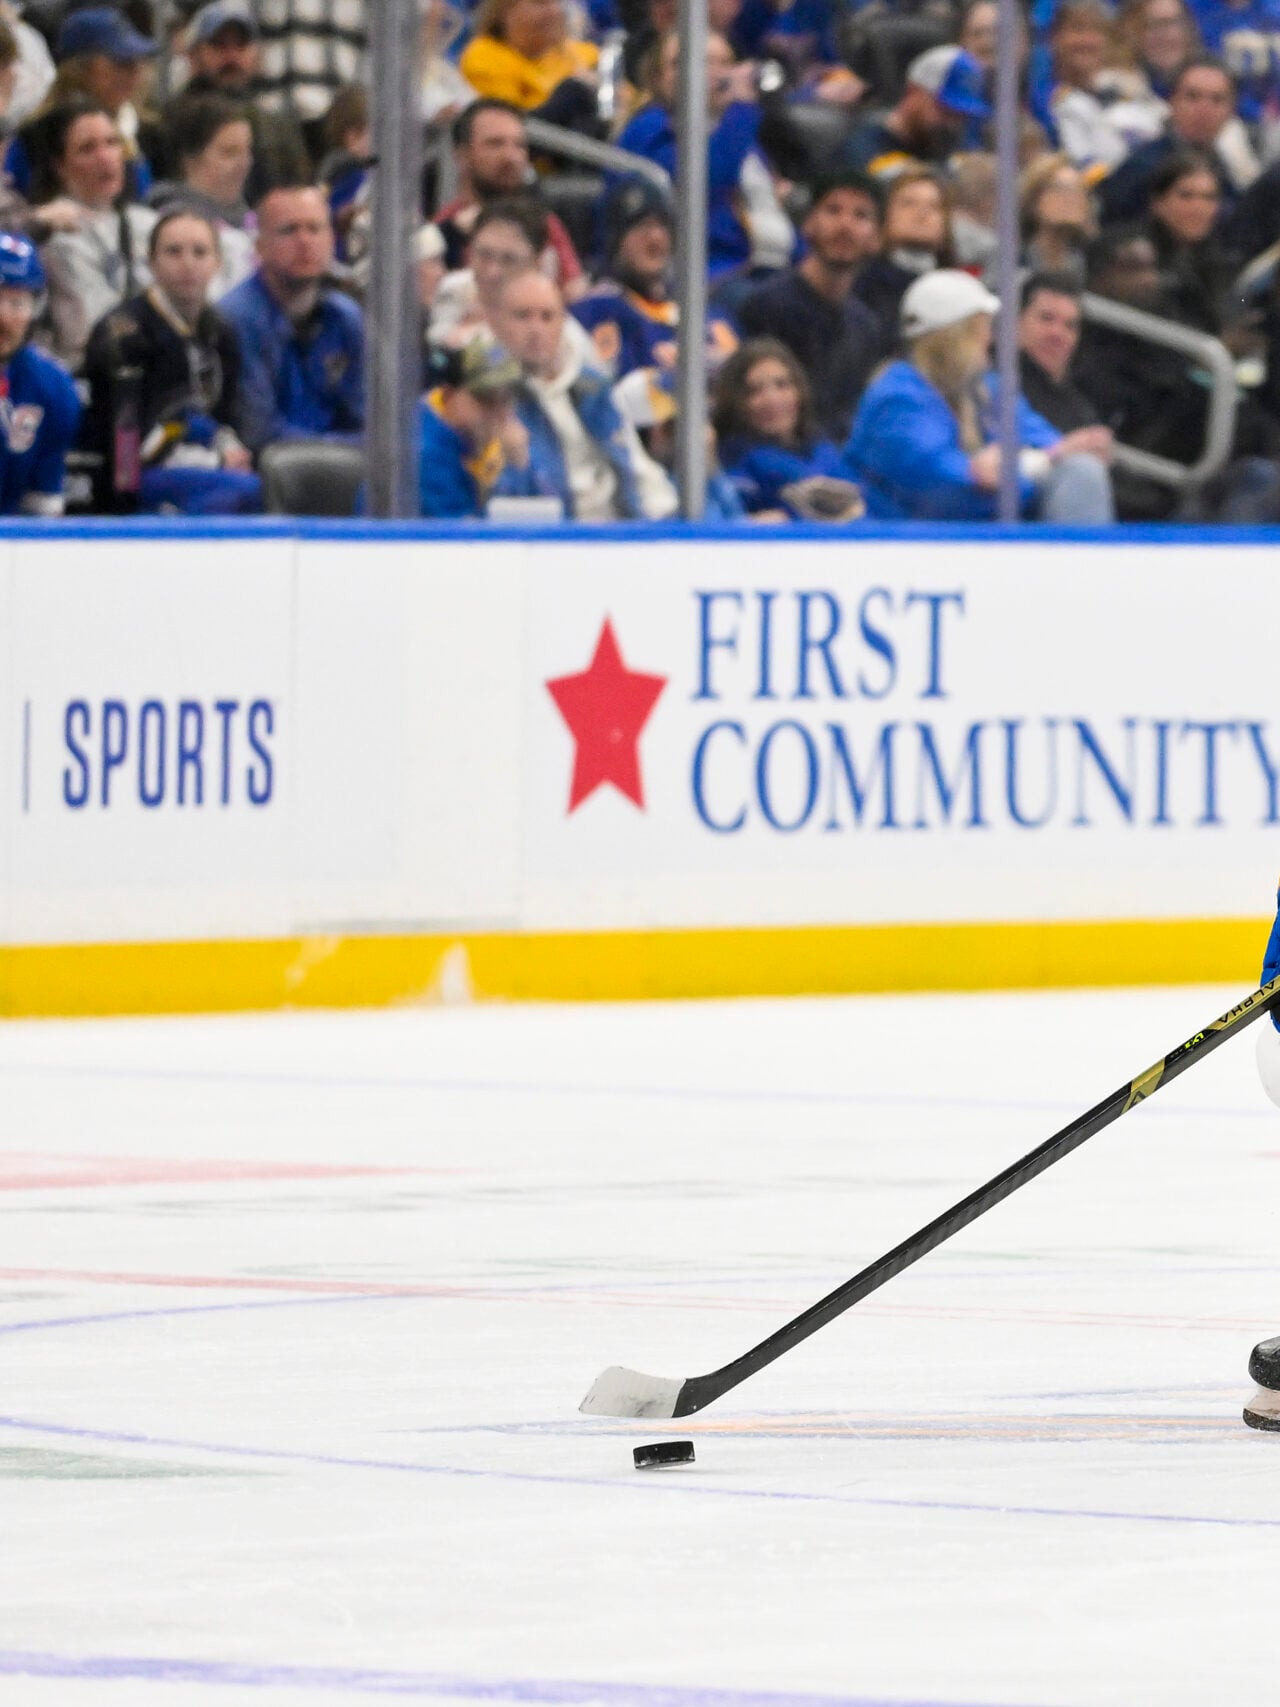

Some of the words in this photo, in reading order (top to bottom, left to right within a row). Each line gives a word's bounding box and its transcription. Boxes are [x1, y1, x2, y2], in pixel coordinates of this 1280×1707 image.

[691, 587, 966, 702] FIRST
[63, 698, 274, 809] SPORTS
[1219, 980, 1275, 1024] ALPHA
